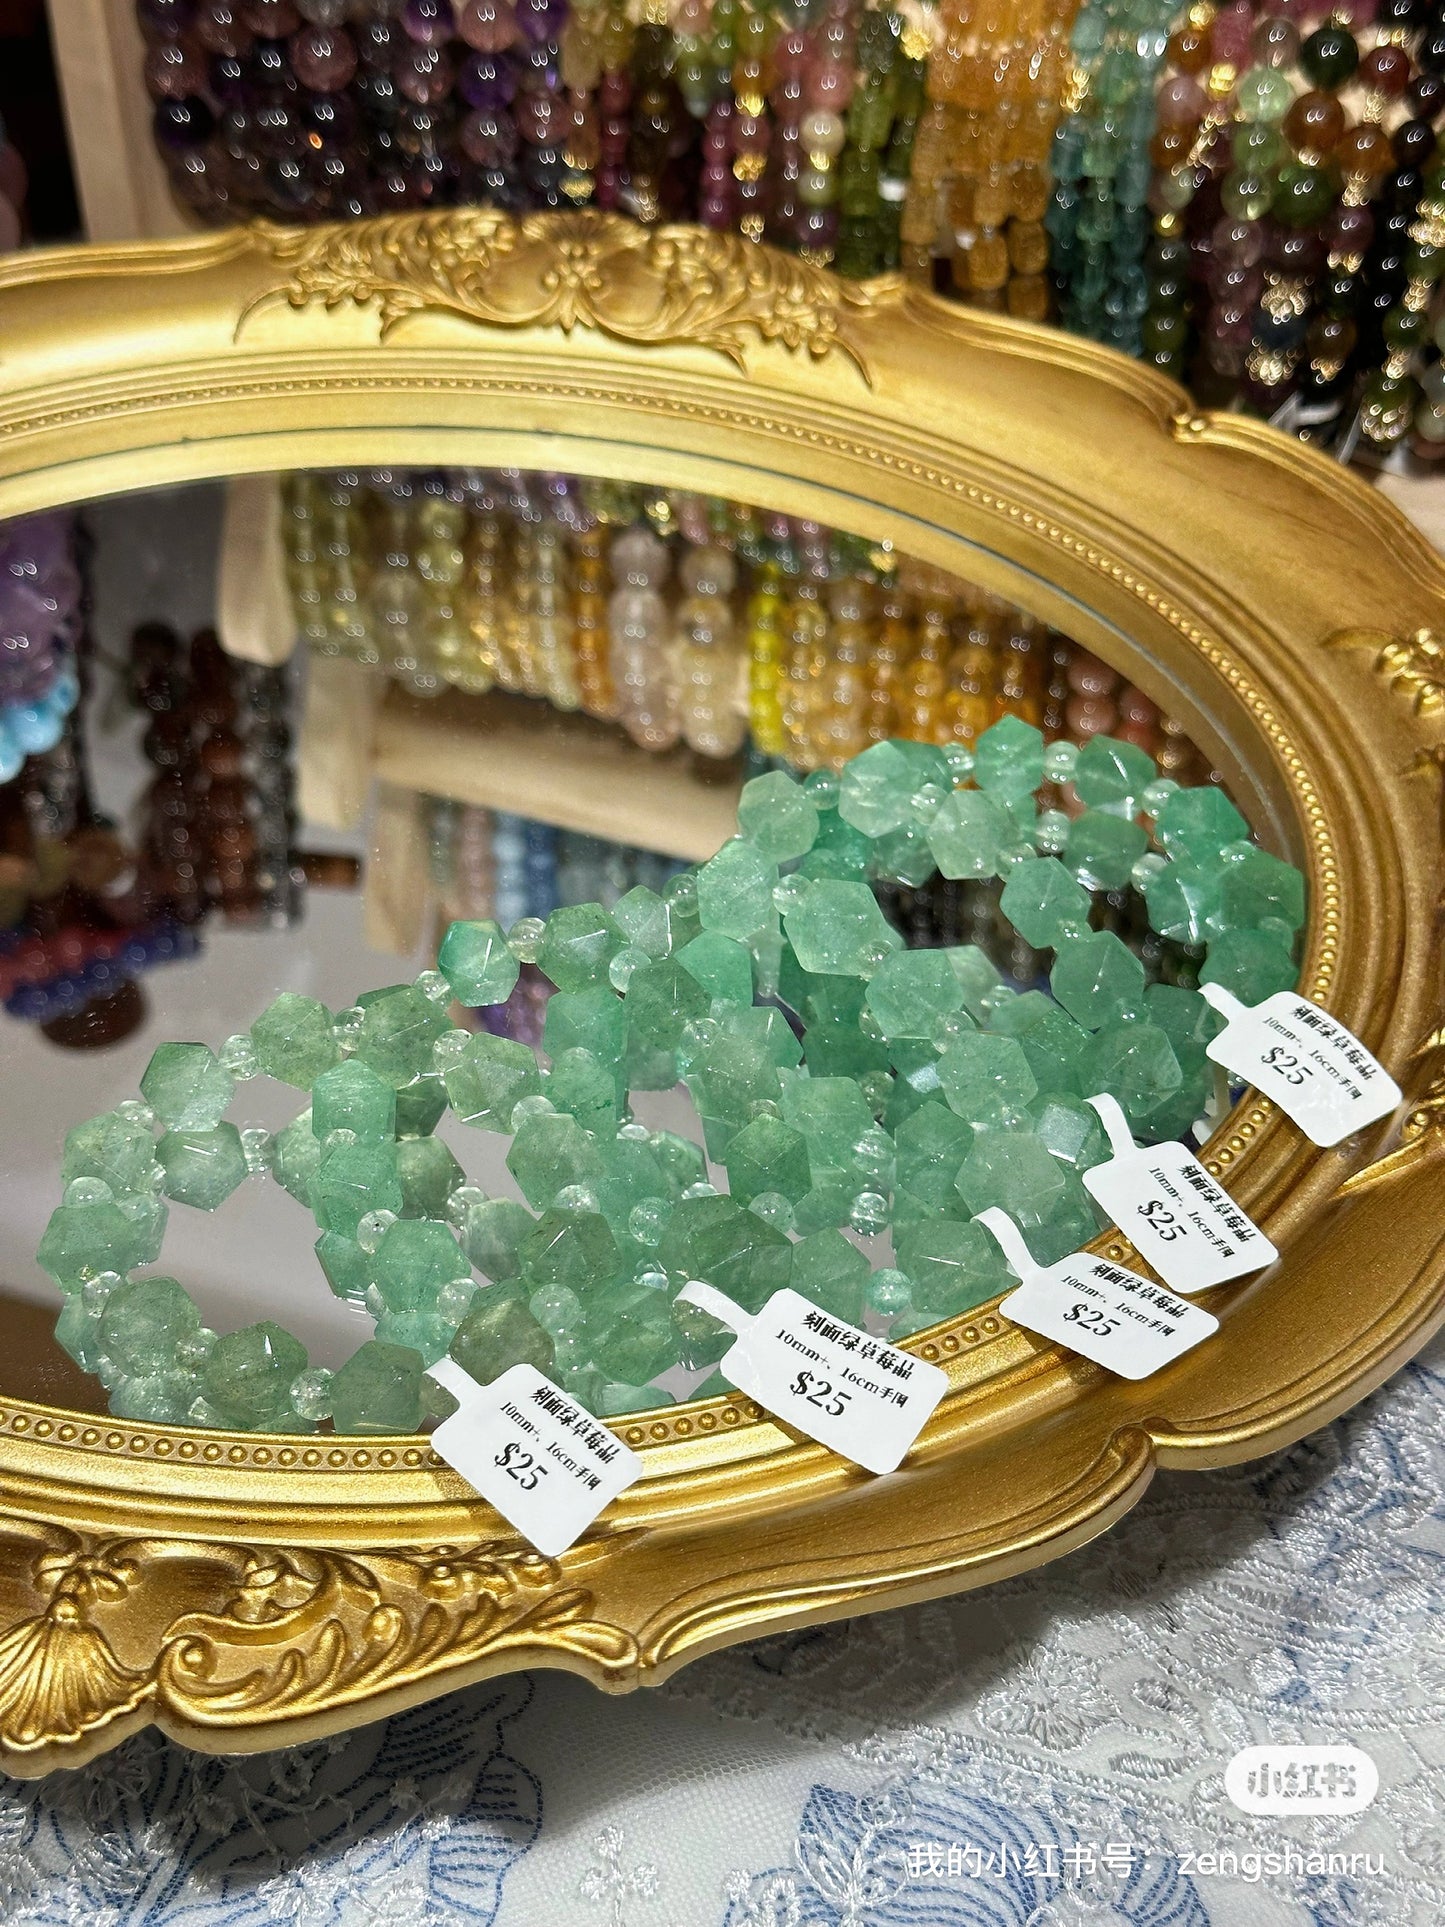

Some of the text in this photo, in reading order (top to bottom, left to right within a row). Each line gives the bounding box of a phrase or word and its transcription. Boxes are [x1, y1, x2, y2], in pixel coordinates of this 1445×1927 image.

[1261, 1046, 1314, 1085] $25
[1137, 1200, 1187, 1242] $25
[1063, 1302, 1121, 1337] $25
[790, 1370, 852, 1416] $25
[494, 1441, 548, 1490] $25
